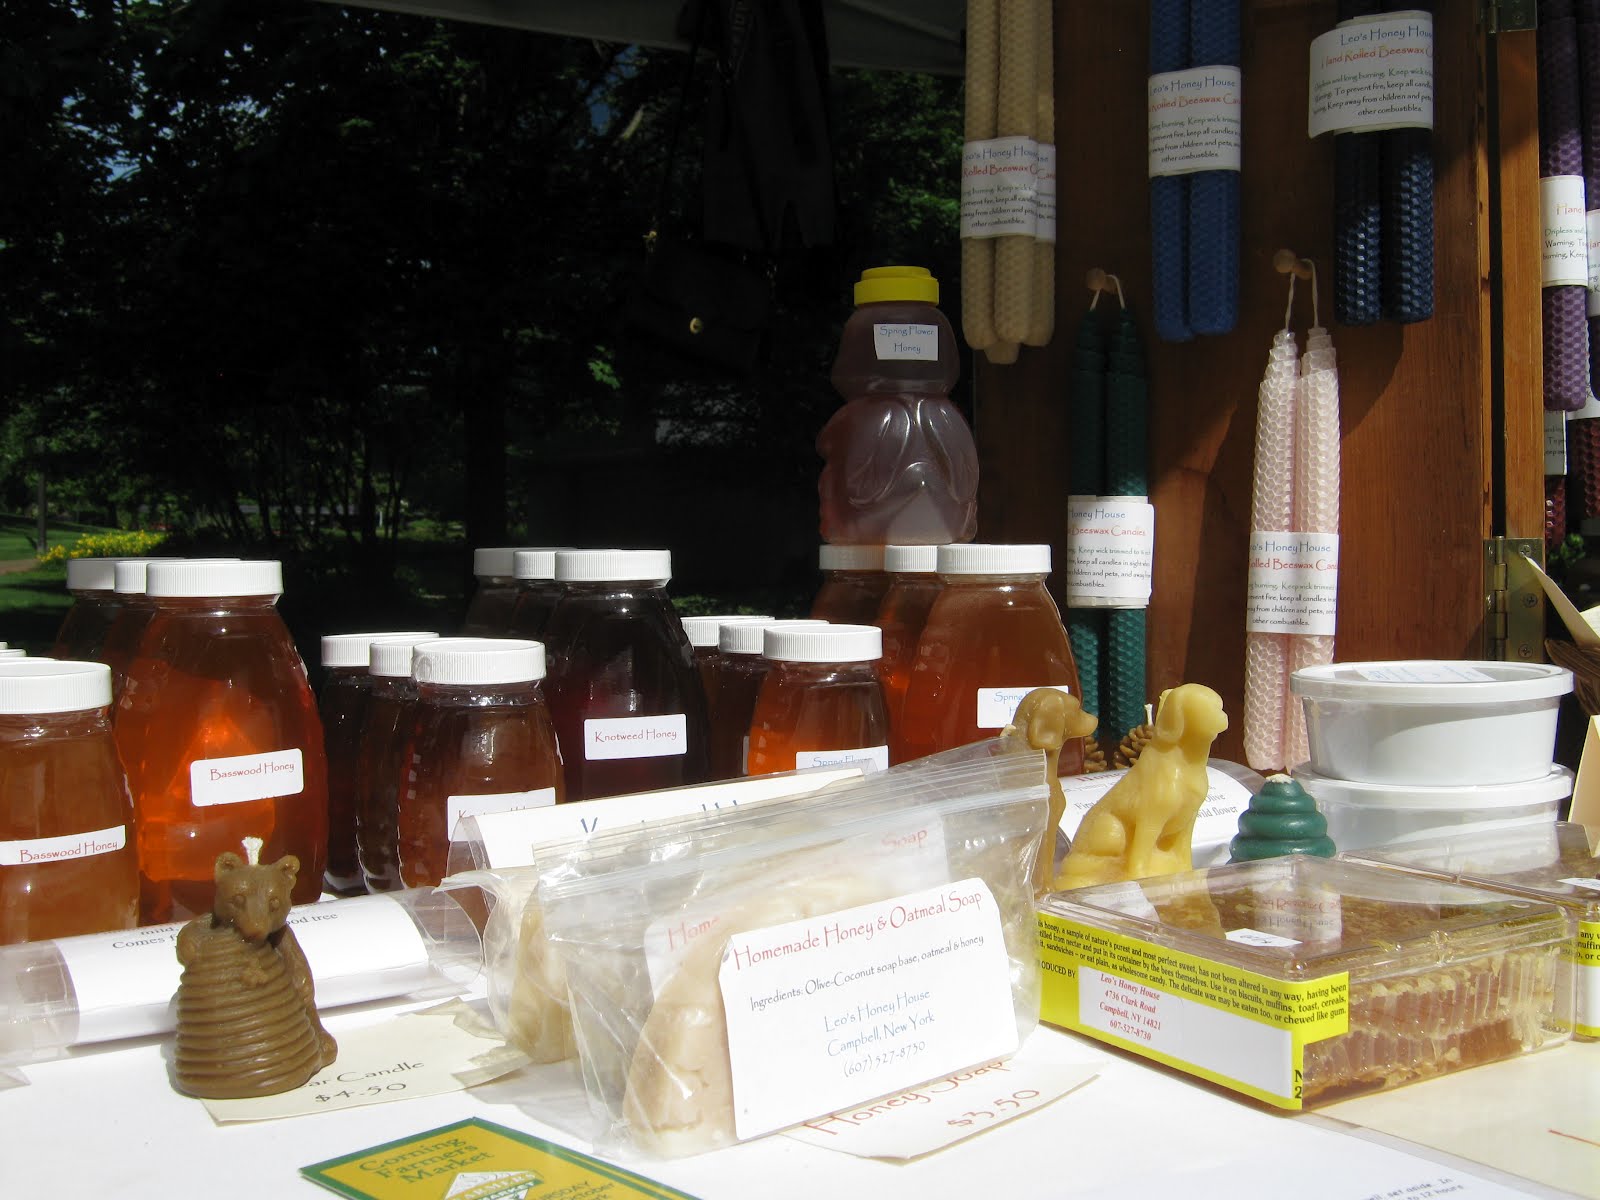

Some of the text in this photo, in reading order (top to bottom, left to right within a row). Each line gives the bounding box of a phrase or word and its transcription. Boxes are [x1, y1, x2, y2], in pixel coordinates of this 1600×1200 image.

[1341, 28, 1405, 46] Leo's Honey
[1379, 44, 1424, 58] Beeswax
[1171, 76, 1235, 92] Honey House
[1346, 85, 1371, 95] prevent
[1387, 81, 1403, 90] keep
[1179, 96, 1221, 108] Beeswax
[1362, 97, 1377, 105] from
[1379, 94, 1406, 103] children
[1180, 141, 1203, 149] children
[983, 148, 1012, 159] Honey
[990, 164, 1028, 176] Beeswax
[989, 207, 1010, 215] children
[880, 326, 933, 337] Spring Flower
[894, 343, 920, 354] Honey
[1095, 508, 1125, 519] House
[1111, 525, 1146, 537] Candles
[1079, 546, 1094, 555] Keep
[1265, 541, 1331, 554] Honey House
[1077, 558, 1090, 567] keep
[1273, 558, 1313, 570] Beeswax
[1282, 582, 1299, 590] Keep
[1280, 594, 1294, 603] keep
[1272, 605, 1295, 613] children
[594, 727, 678, 743] Knotweed Honey
[210, 761, 295, 781] Basswood Honey
[20, 840, 118, 863] Basswood Honey
[311, 912, 338, 922] tree
[734, 890, 981, 971] Homemade Honey & Oatmeal Soap
[112, 936, 166, 949] Comes
[750, 936, 984, 1011] Ingredients: Olive-Coconut soap base, oatmeal honey
[1053, 934, 1065, 943] from
[1083, 944, 1092, 952] and
[1143, 961, 1149, 971] by
[1151, 963, 1159, 973] the
[1210, 981, 1221, 992] Use
[1266, 999, 1295, 1013] muffins,
[1299, 1003, 1319, 1012] toast,
[1066, 929, 1083, 939] sample
[1092, 936, 1112, 947] nature's
[1114, 943, 1130, 953] purest
[1132, 948, 1141, 956] and
[1143, 951, 1156, 962] most
[1158, 956, 1177, 968] perfect
[1199, 966, 1209, 976] has
[1211, 971, 1221, 980] not
[1223, 973, 1237, 984] been
[1239, 979, 1260, 991] altered
[1270, 990, 1281, 999] any
[1284, 994, 1304, 1002] way,
[1307, 988, 1329, 999] having
[1331, 984, 1346, 993] been
[1068, 969, 1075, 978] BY
[1101, 973, 1160, 1000] Leo's Honey House
[1105, 990, 1156, 1013] 4736 Clark Road
[1169, 979, 1179, 990] The
[1181, 983, 1203, 998] delicate
[1232, 999, 1240, 1008] be
[1241, 1005, 1258, 1014] eaten
[1284, 1013, 1315, 1024] chewed
[1317, 1011, 1328, 1021] like
[1330, 1008, 1346, 1019] gum.
[824, 992, 930, 1032] Leo's Honey House
[1099, 1001, 1161, 1030] Campbell, NY 14821
[827, 1009, 935, 1056] Campbell, New York
[843, 1041, 925, 1077] (607) 527-8730
[337, 1062, 425, 1082] Candle
[315, 1083, 406, 1102] $4.50
[802, 1091, 931, 1136] Honey
[946, 1089, 1040, 1127] $3.50
[359, 1138, 467, 1173] Corning
[375, 1144, 479, 1179] Farmers
[399, 1151, 495, 1184] Market
